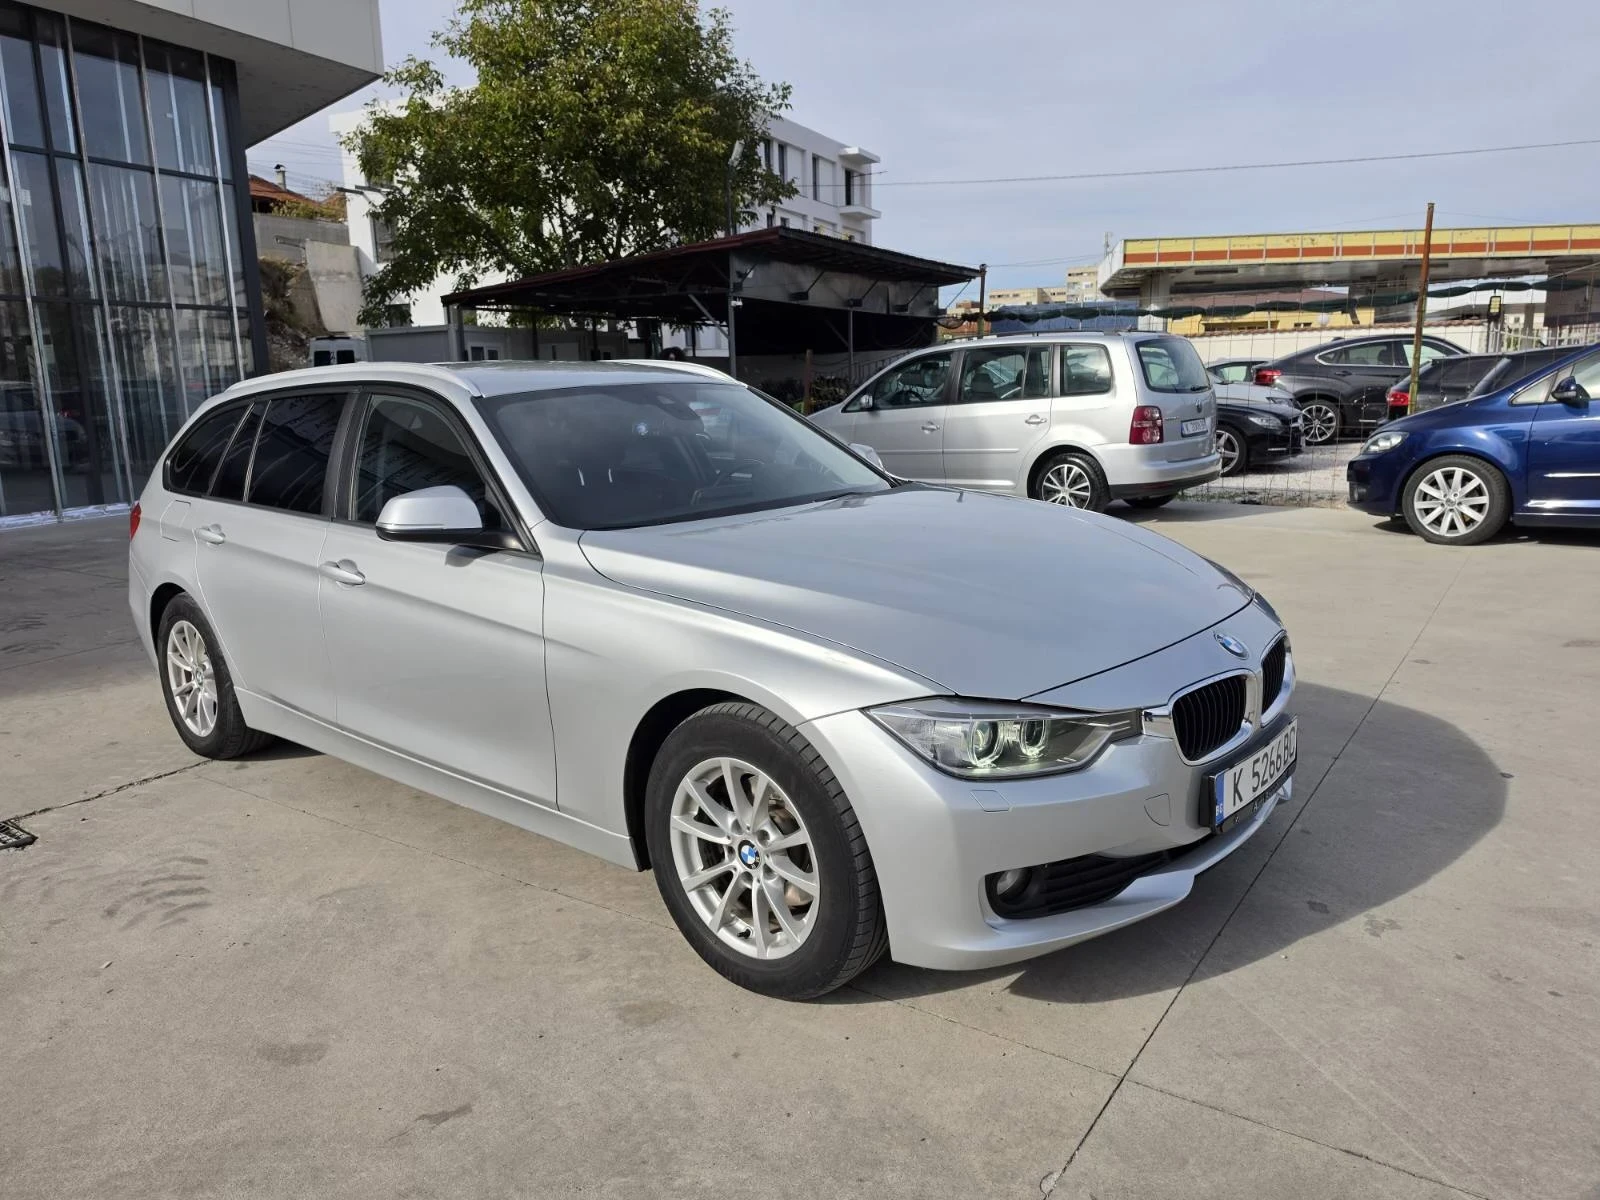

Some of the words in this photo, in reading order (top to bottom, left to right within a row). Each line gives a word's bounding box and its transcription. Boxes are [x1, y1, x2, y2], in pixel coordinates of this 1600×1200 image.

[1233, 768, 1243, 807] K
[1252, 739, 1282, 792] 5266
[1284, 727, 1295, 765] BC
